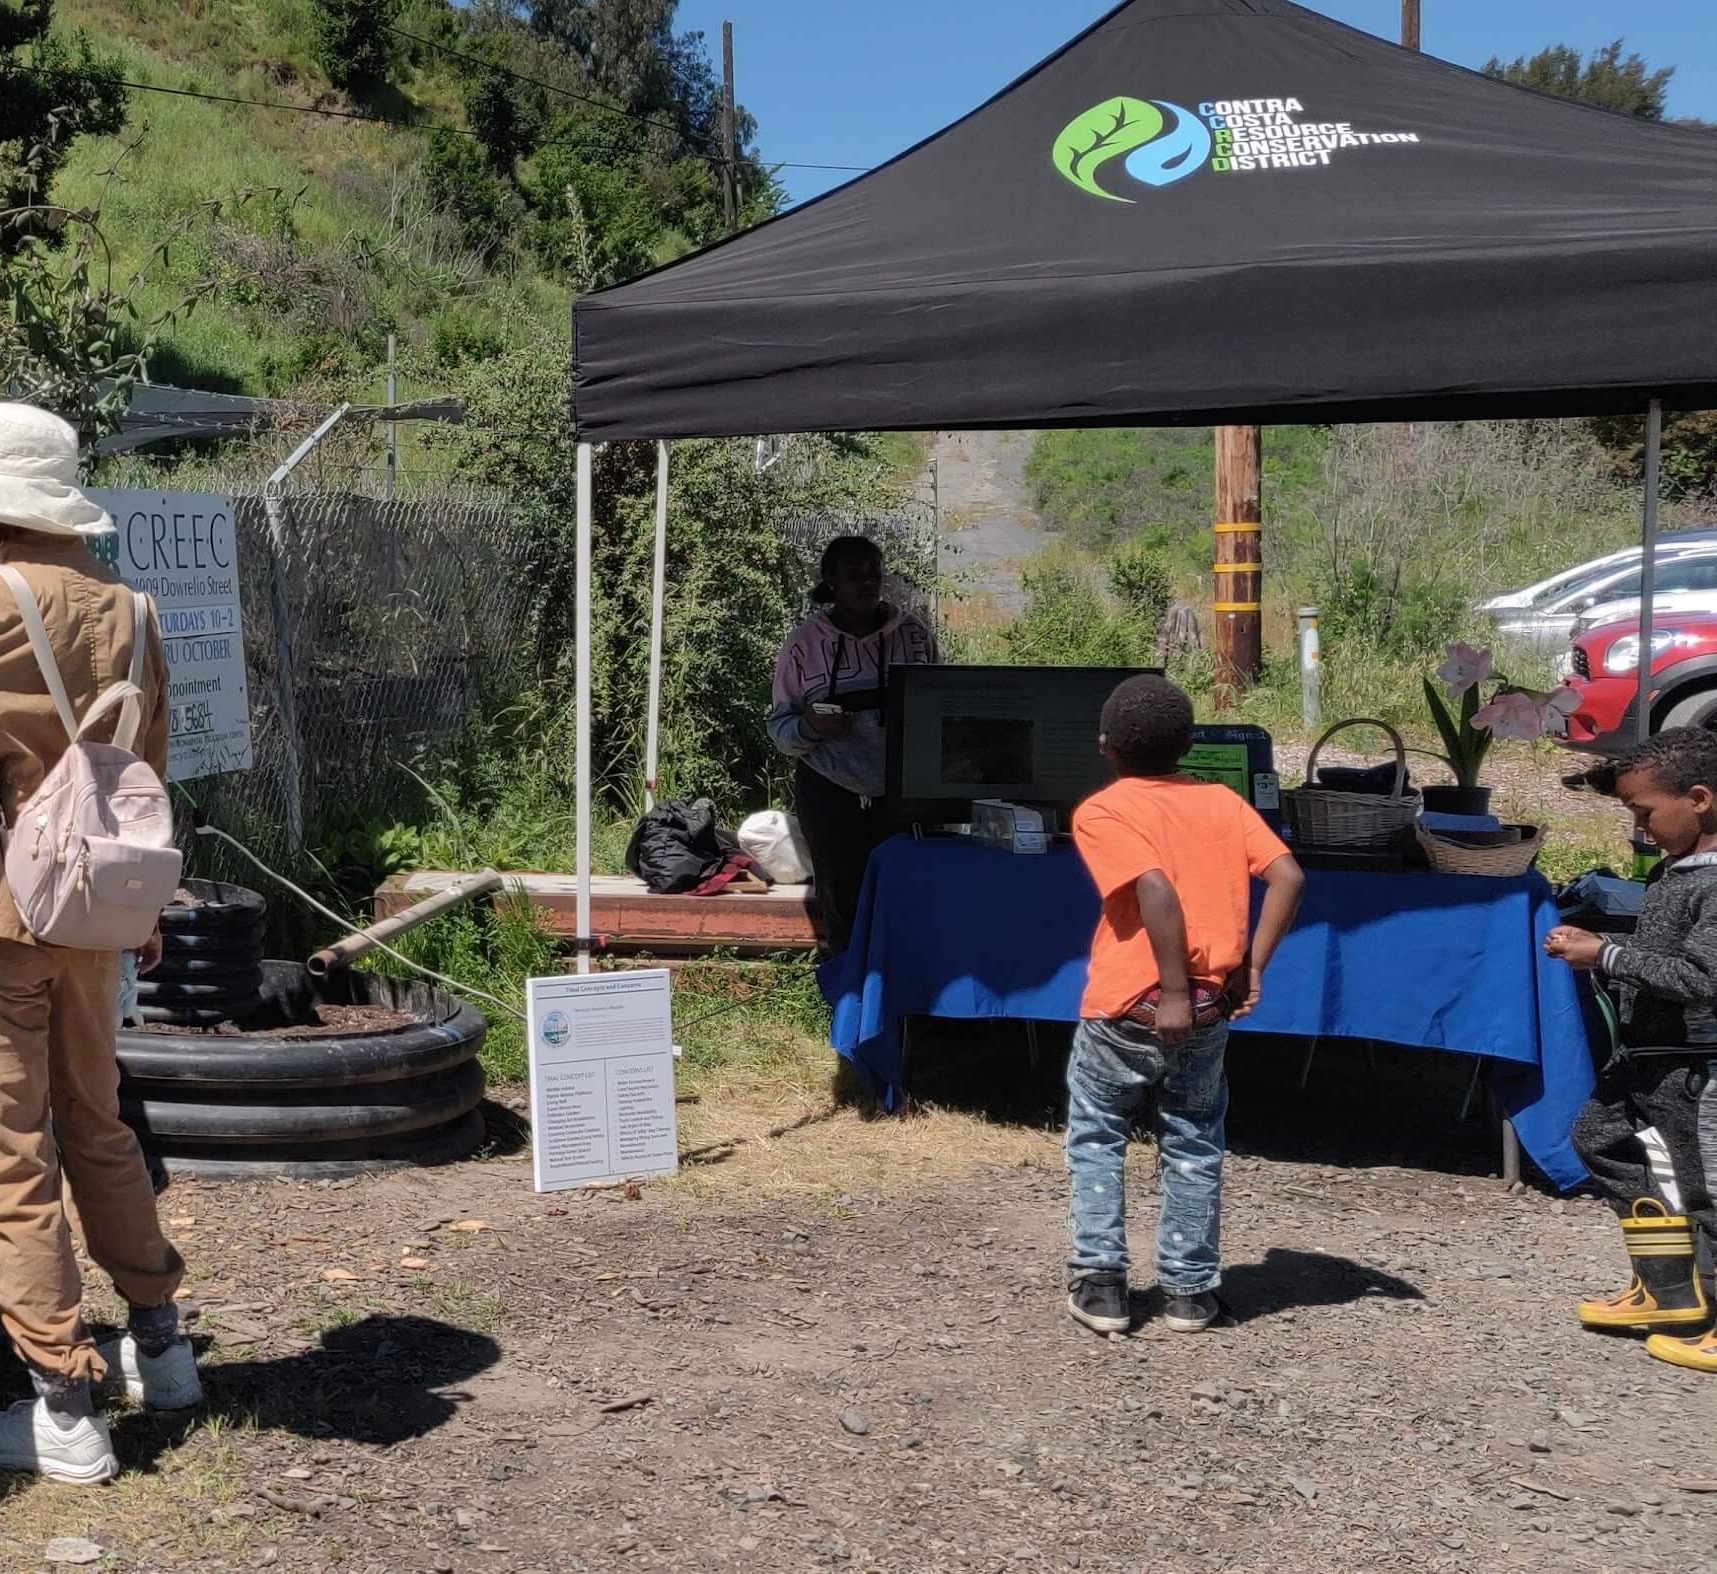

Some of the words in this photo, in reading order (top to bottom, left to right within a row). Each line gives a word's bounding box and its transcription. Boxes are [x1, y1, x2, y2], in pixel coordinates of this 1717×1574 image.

[1198, 98, 1303, 117] CONTRA
[1209, 111, 1293, 130] COSTA
[1214, 123, 1354, 143] RESOURCE
[1215, 132, 1420, 157] CONSERVATION
[1211, 149, 1332, 172] DISTRICT
[207, 575, 232, 595] Street
[210, 607, 234, 628] 10-2
[183, 639, 232, 663] OCTOBER
[184, 700, 213, 731] 5684
